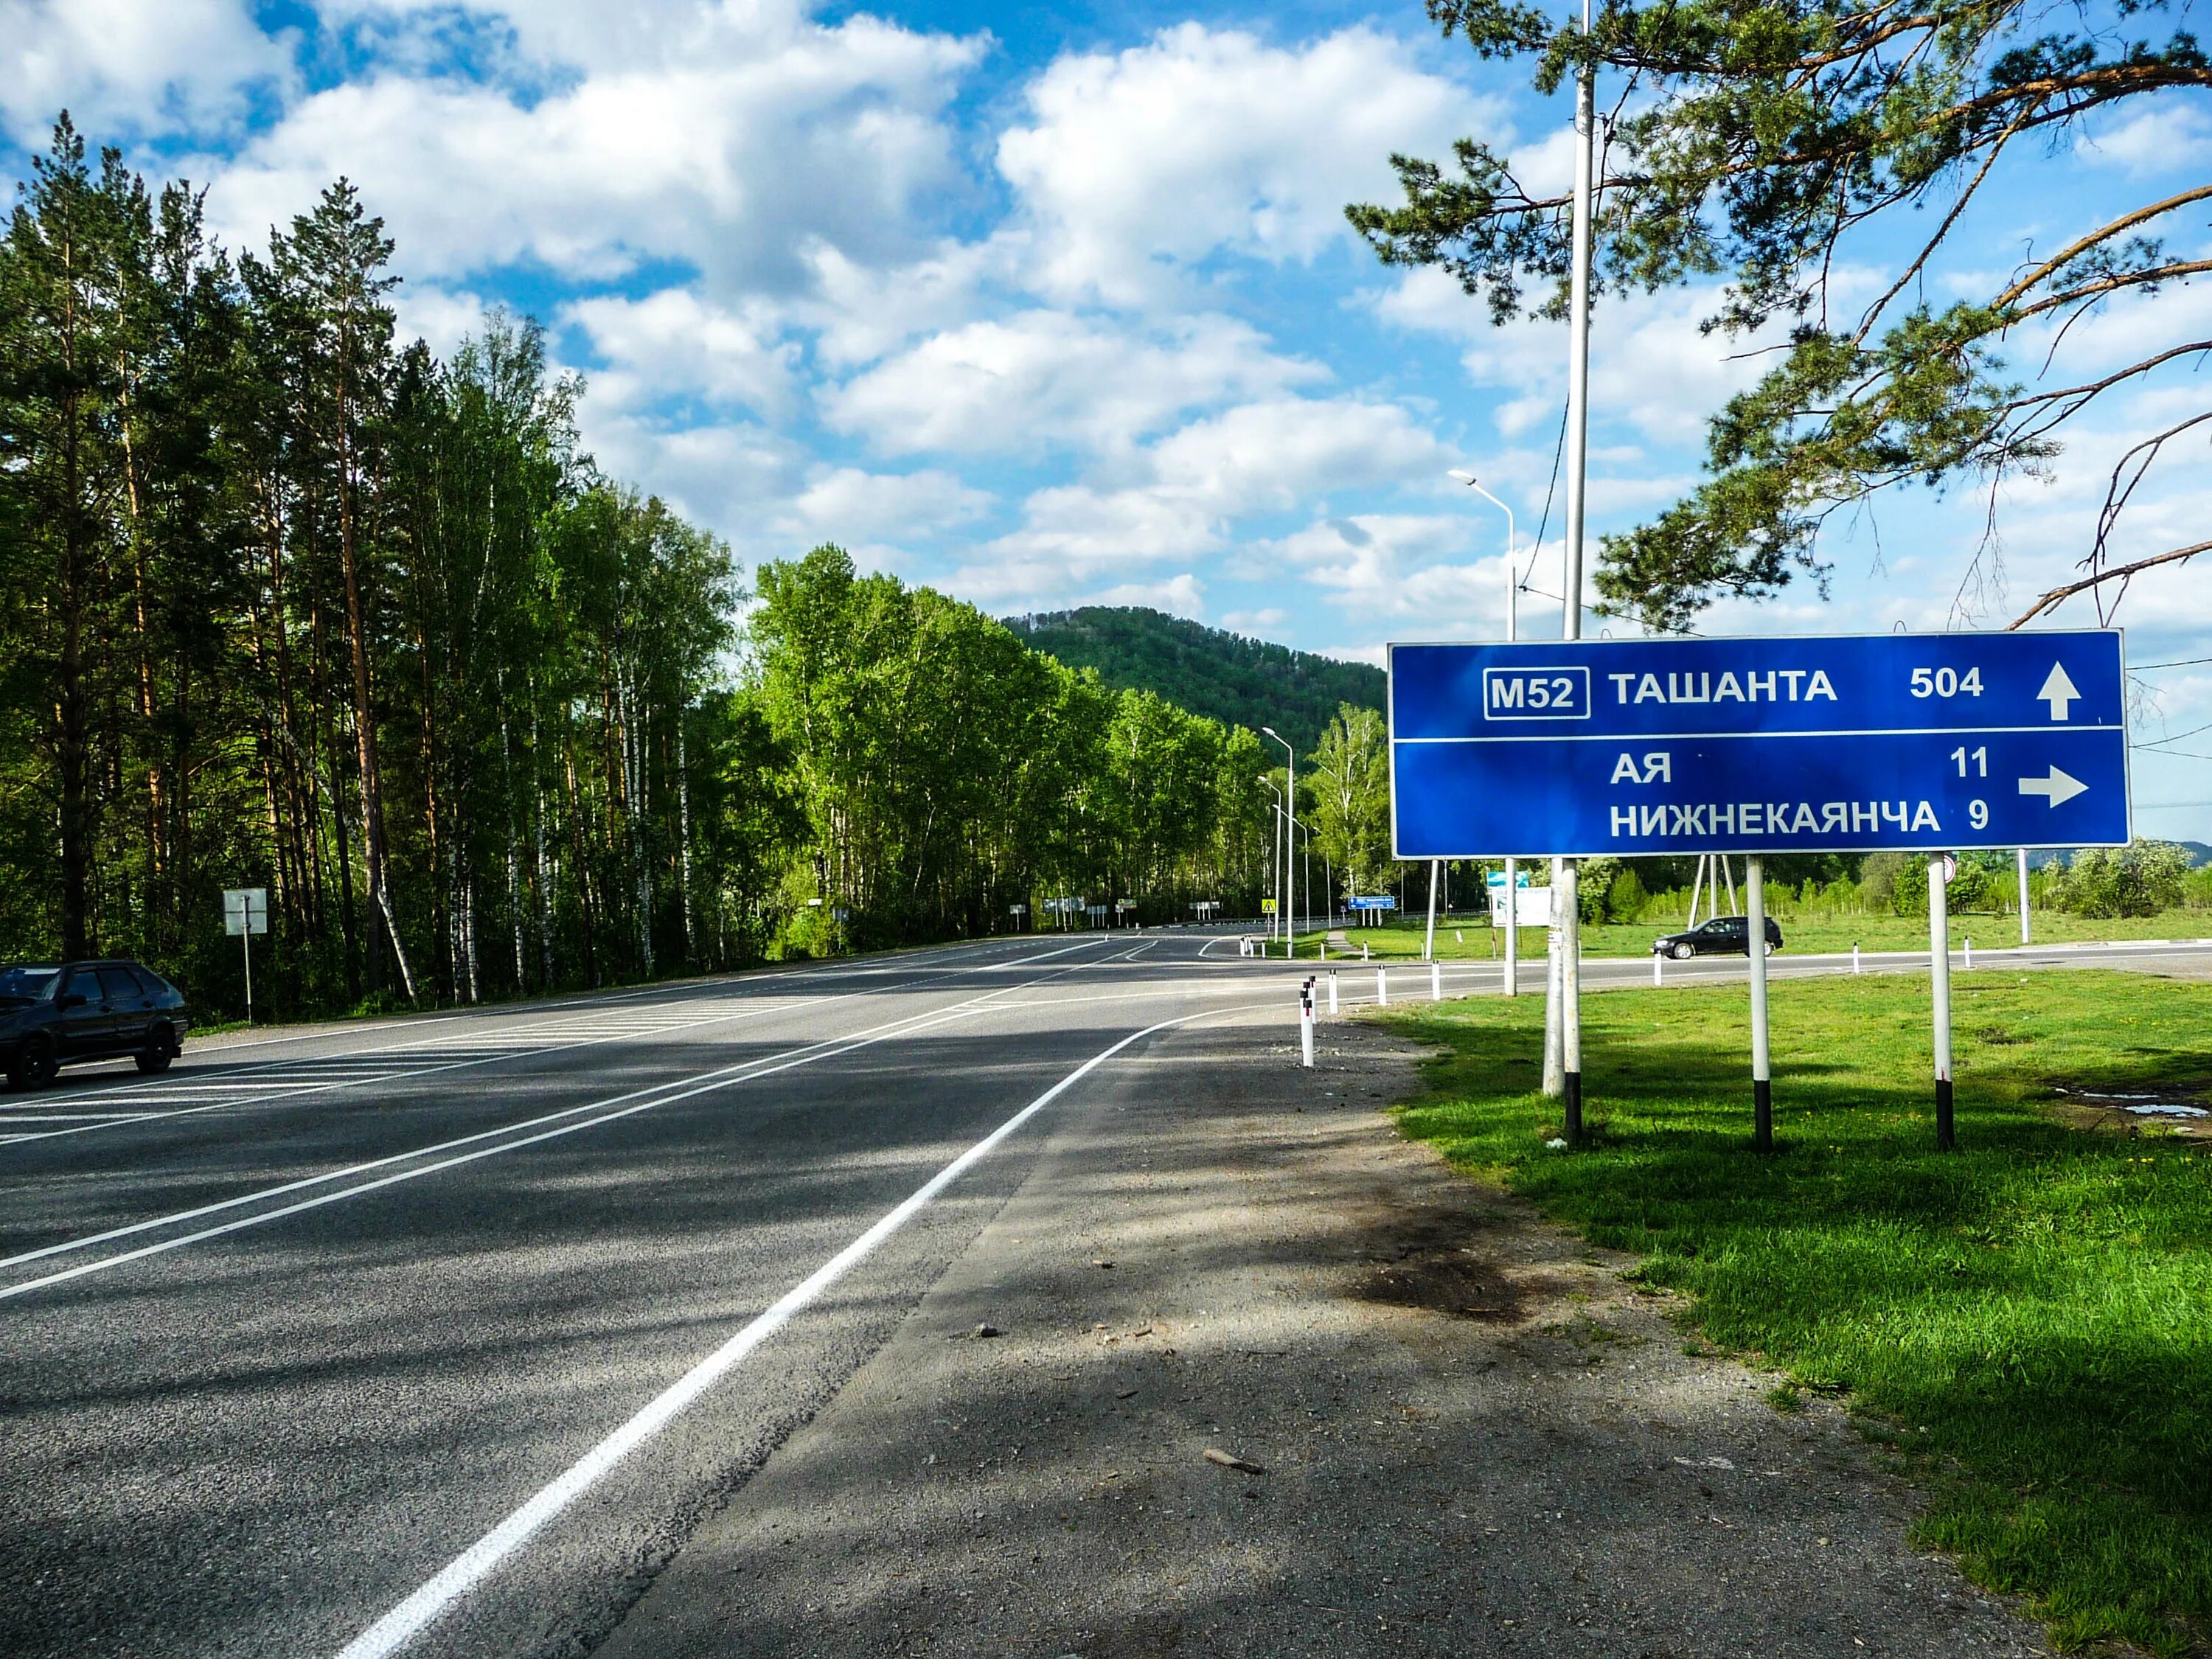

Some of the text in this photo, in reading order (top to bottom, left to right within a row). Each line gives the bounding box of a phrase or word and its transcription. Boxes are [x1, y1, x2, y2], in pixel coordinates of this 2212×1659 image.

[1608, 670, 1837, 704] ТАШАНТА
[1910, 667, 1984, 698] 504
[1610, 746, 1987, 784] АЯ 11
[1610, 799, 1989, 837] НИЖНЕКАЯНЧА 9
